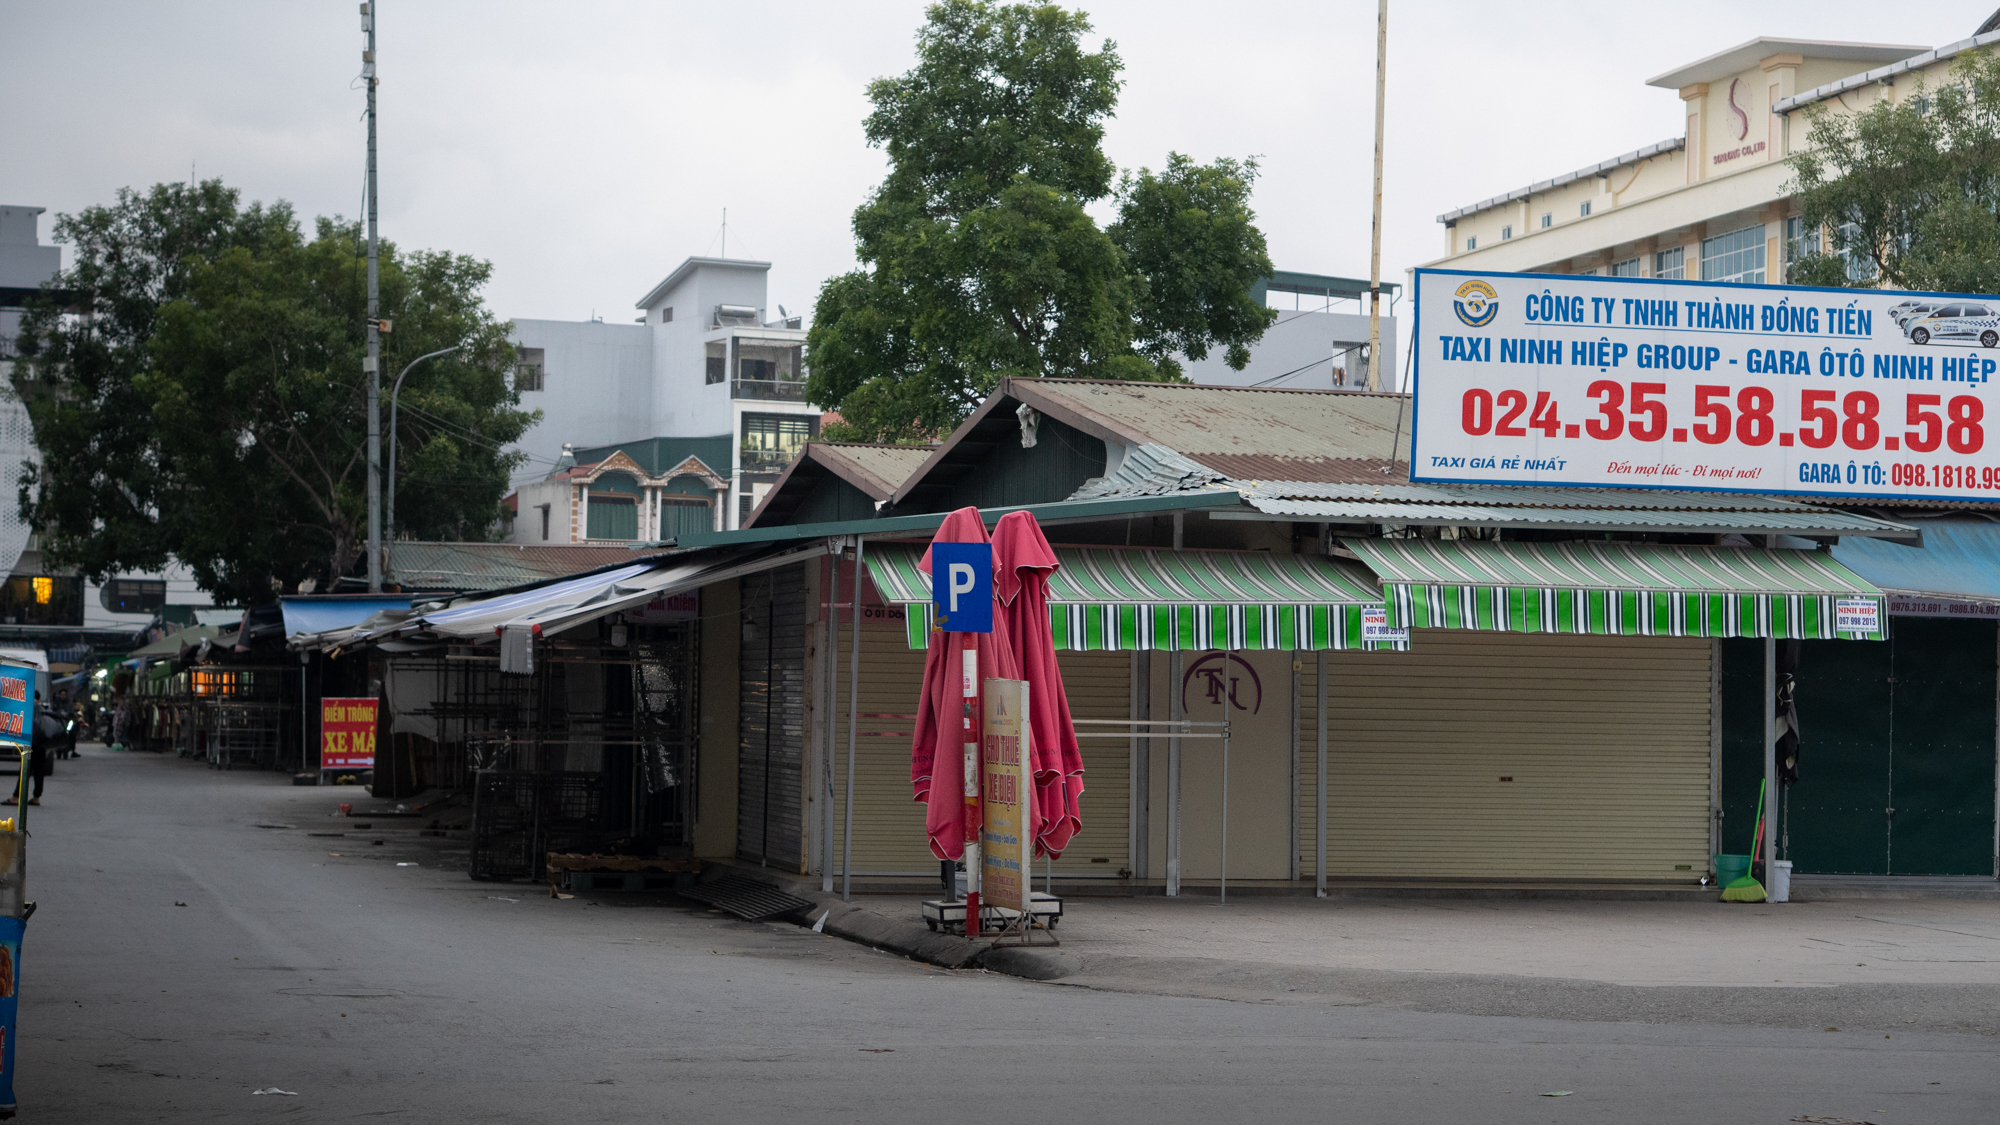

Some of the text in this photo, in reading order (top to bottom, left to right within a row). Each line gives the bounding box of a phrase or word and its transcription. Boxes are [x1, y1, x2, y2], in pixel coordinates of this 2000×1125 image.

[1525, 289, 1872, 336] CÔNG TY TNHH THÀNH ĐỒNG TIẾN
[1440, 335, 1491, 362] TAXI
[1500, 338, 1562, 365] NINH
[1571, 337, 1628, 372] HIỆP
[1637, 343, 1720, 371] GROUP
[1746, 348, 1811, 376] GARA
[1819, 347, 1865, 378] ÔTÔ
[1873, 354, 1933, 381] NINH
[1942, 353, 1997, 388] HIỆP
[1461, 380, 1984, 455] 024.35.58.58.58
[1431, 454, 1567, 471] TAXI GIÁ RẺ NHẤT
[1607, 461, 1631, 475] Đến
[1634, 463, 1659, 478] mọi
[1661, 463, 1682, 476] lúc
[1692, 465, 1708, 478] Đi
[1710, 467, 1733, 481] mọi
[1736, 467, 1762, 479] nơi!
[1799, 462, 1841, 484] GARA
[1846, 460, 1857, 485] Ô
[1862, 460, 1887, 485] TÔ:
[949, 563, 975, 612] P
[875, 609, 885, 618] 01
[1859, 606, 1877, 617] HIỆP
[1891, 602, 1941, 613] 0976.313.691
[1366, 626, 1376, 635] 097
[1378, 626, 1389, 635] 998
[1839, 616, 1876, 626] 097 998 2015
[1, 677, 26, 702] GIANG
[324, 731, 348, 753] XE
[986, 729, 1020, 766] CHO THUÊ
[988, 768, 1017, 811] XE ĐIỆN
